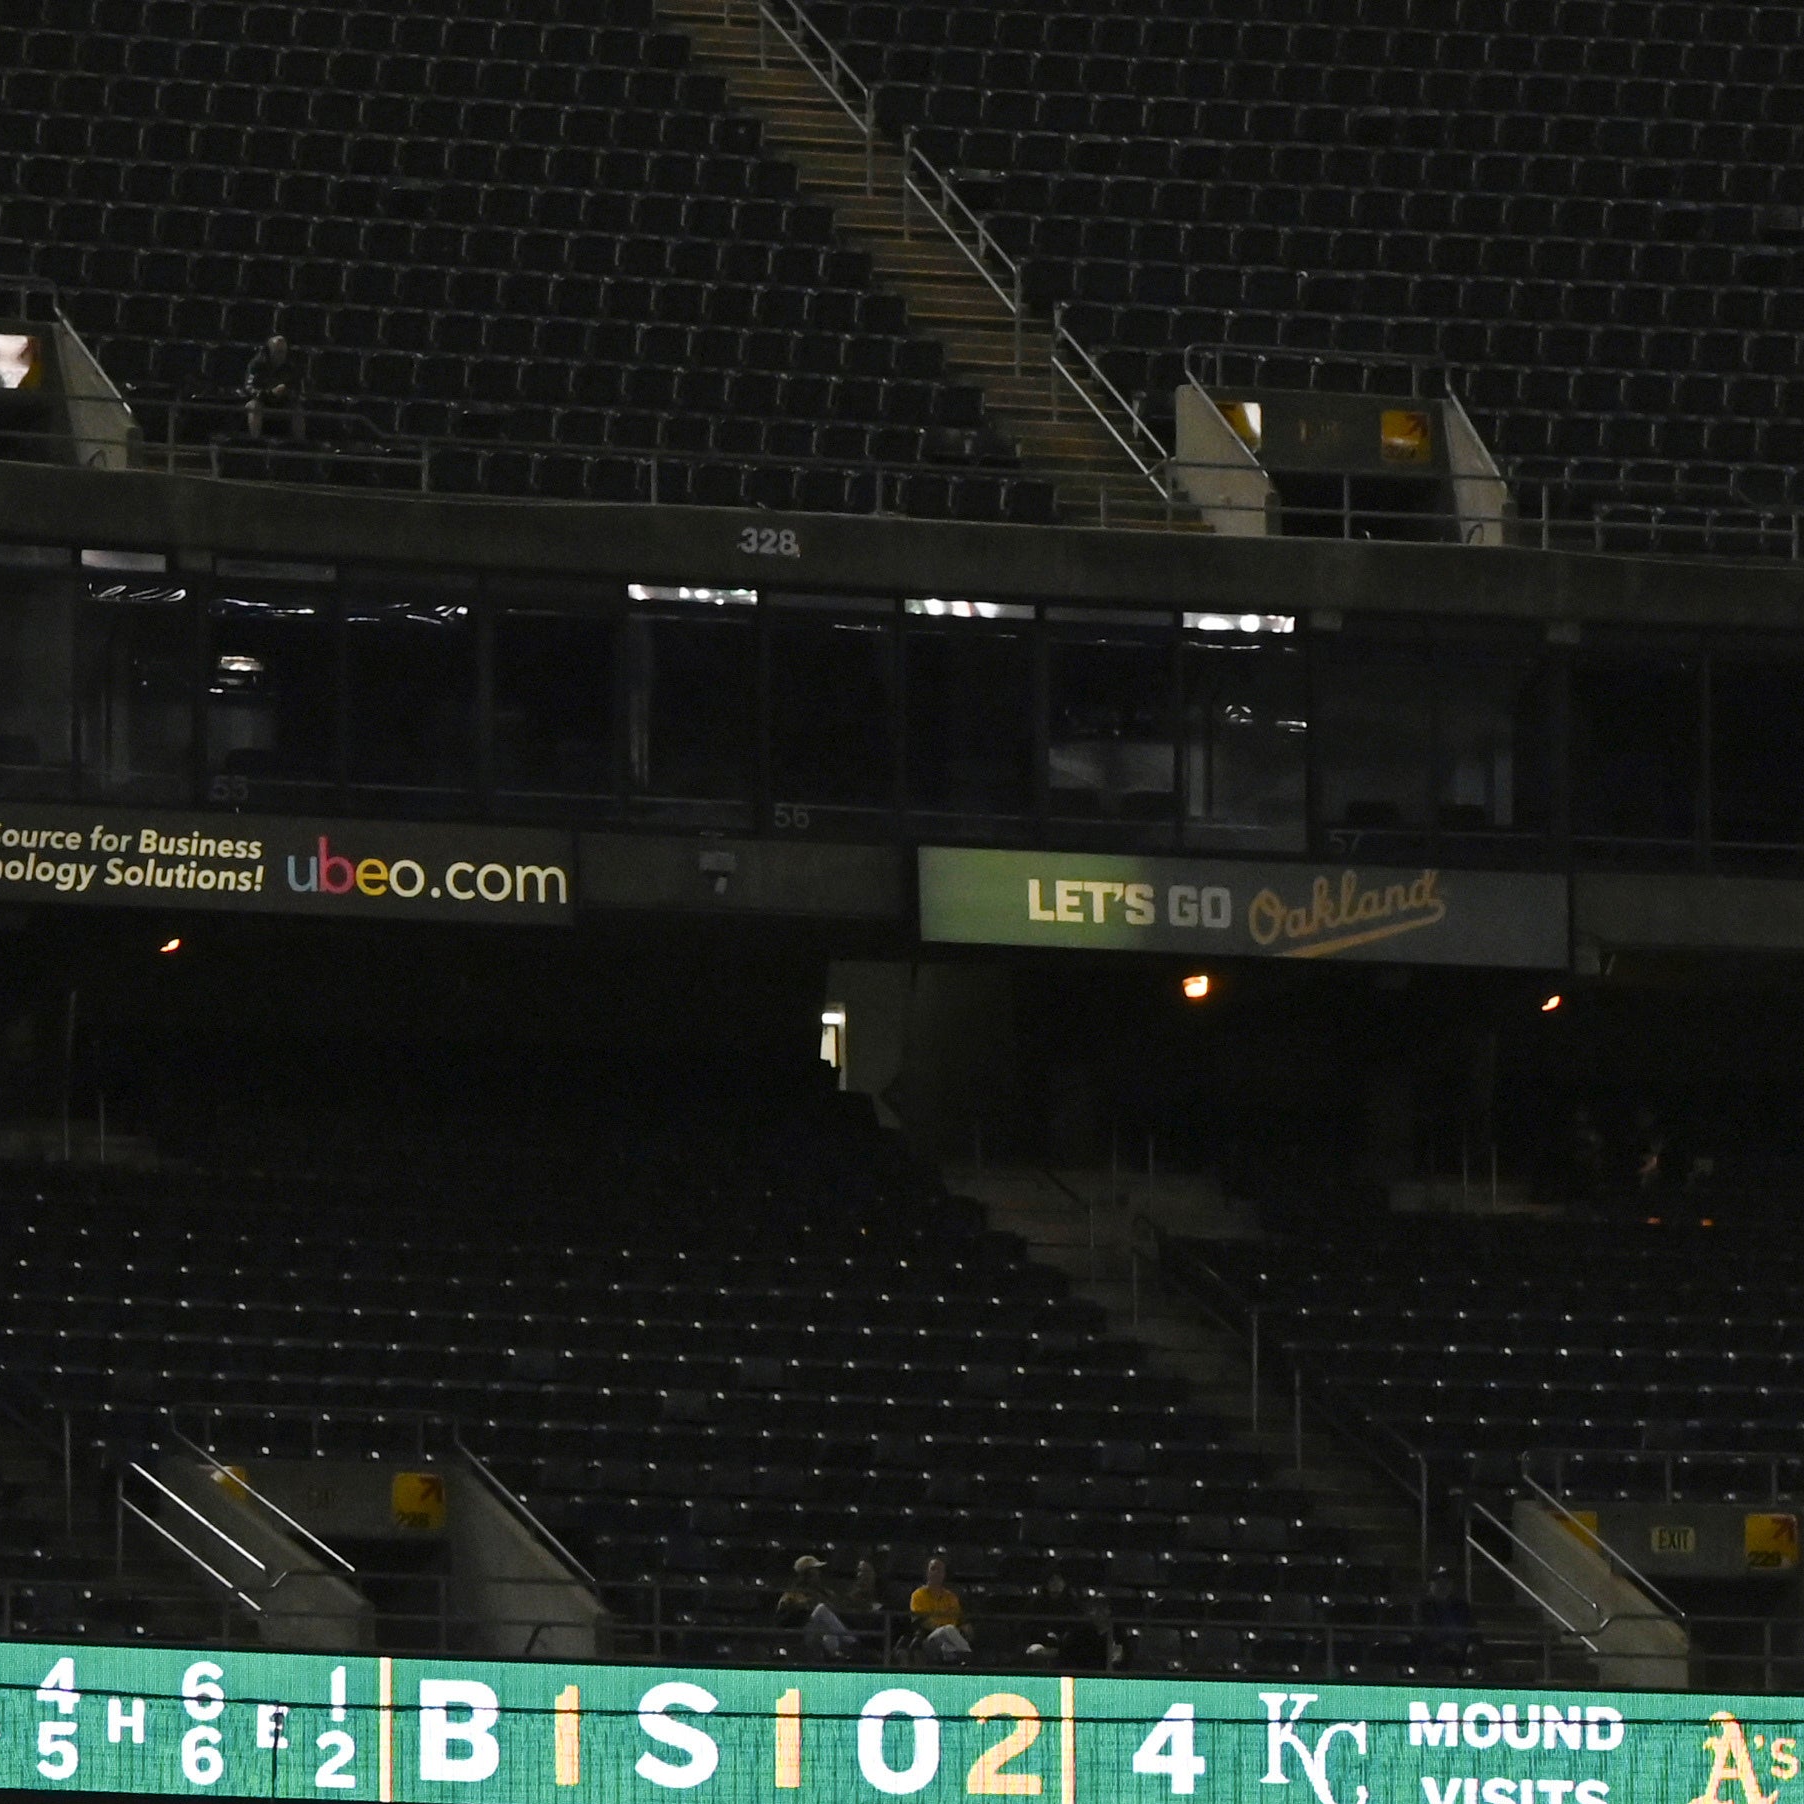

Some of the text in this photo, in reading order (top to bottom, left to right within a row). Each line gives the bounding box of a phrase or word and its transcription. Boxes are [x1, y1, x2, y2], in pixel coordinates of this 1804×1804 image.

[739, 527, 798, 555] 328
[90, 825, 132, 853] for
[139, 830, 262, 859] Business
[773, 803, 811, 830] 56
[104, 858, 264, 893] Solutions!
[288, 837, 568, 903] ubeo.com
[1028, 869, 1445, 947] LET'S GO Oakland
[1657, 1528, 1690, 1550] EXIT
[37, 1658, 80, 1714] 4
[181, 1661, 225, 1719] 6
[330, 1666, 346, 1722] 1
[108, 1698, 144, 1744] H
[257, 1702, 288, 1749] E
[418, 1679, 500, 1783] B
[555, 1684, 580, 1786] 1
[634, 1681, 721, 1789] S
[775, 1688, 802, 1788] 1
[966, 1693, 1043, 1796] 2
[1131, 1703, 1209, 1795] 4
[1408, 1701, 1624, 1753] MOUND
[37, 1723, 79, 1781] 5
[181, 1727, 225, 1785] 6
[315, 1731, 356, 1788] 2
